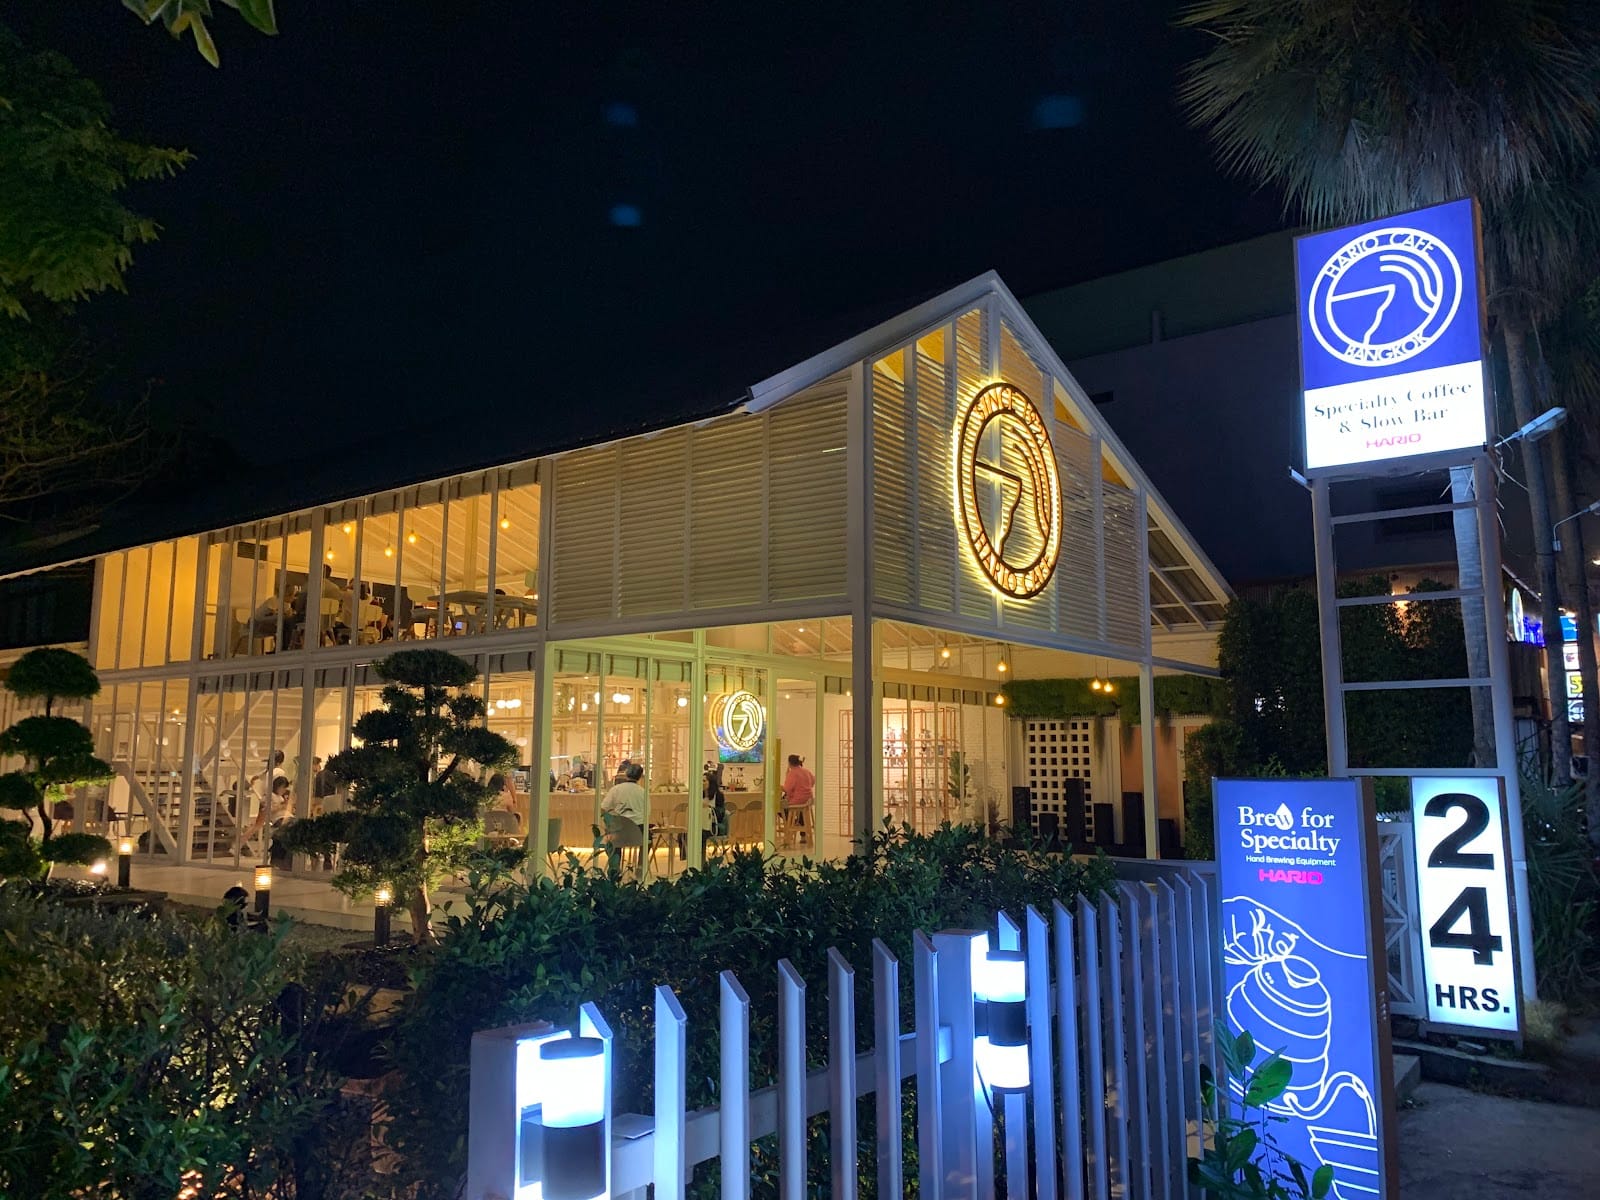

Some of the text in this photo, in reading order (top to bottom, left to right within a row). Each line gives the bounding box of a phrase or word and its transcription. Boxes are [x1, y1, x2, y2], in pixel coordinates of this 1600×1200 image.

[1326, 232, 1436, 278] HARIO CAFE
[1344, 328, 1430, 362] BANGKOK
[1314, 383, 1472, 420] Specialty Coffee
[1339, 407, 1449, 434] & Slow Bar
[1366, 433, 1422, 449] HARIO
[974, 532, 1017, 592] HARIO
[1237, 802, 1335, 830] Brew for
[1240, 828, 1341, 856] Specialty
[1245, 854, 1337, 867] Hand Brewing Equipment
[1258, 868, 1323, 885] HARIO
[1434, 983, 1511, 1013] HRS.
